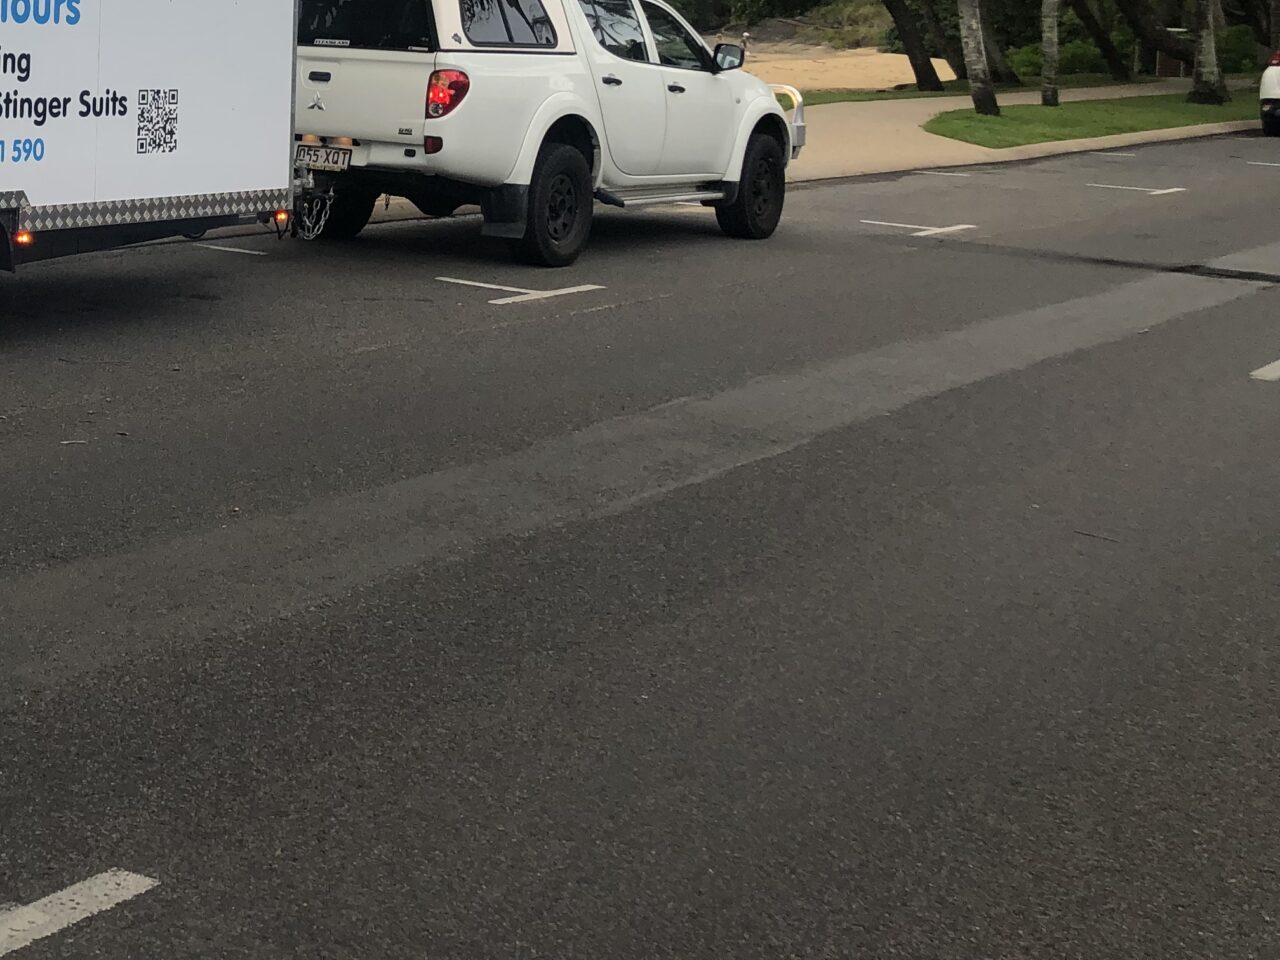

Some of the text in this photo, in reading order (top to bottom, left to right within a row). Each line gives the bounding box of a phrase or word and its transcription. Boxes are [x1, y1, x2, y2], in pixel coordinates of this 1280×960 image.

[78, 88, 128, 117] Suits
[11, 138, 45, 162] 590
[323, 150, 349, 165] XQT
